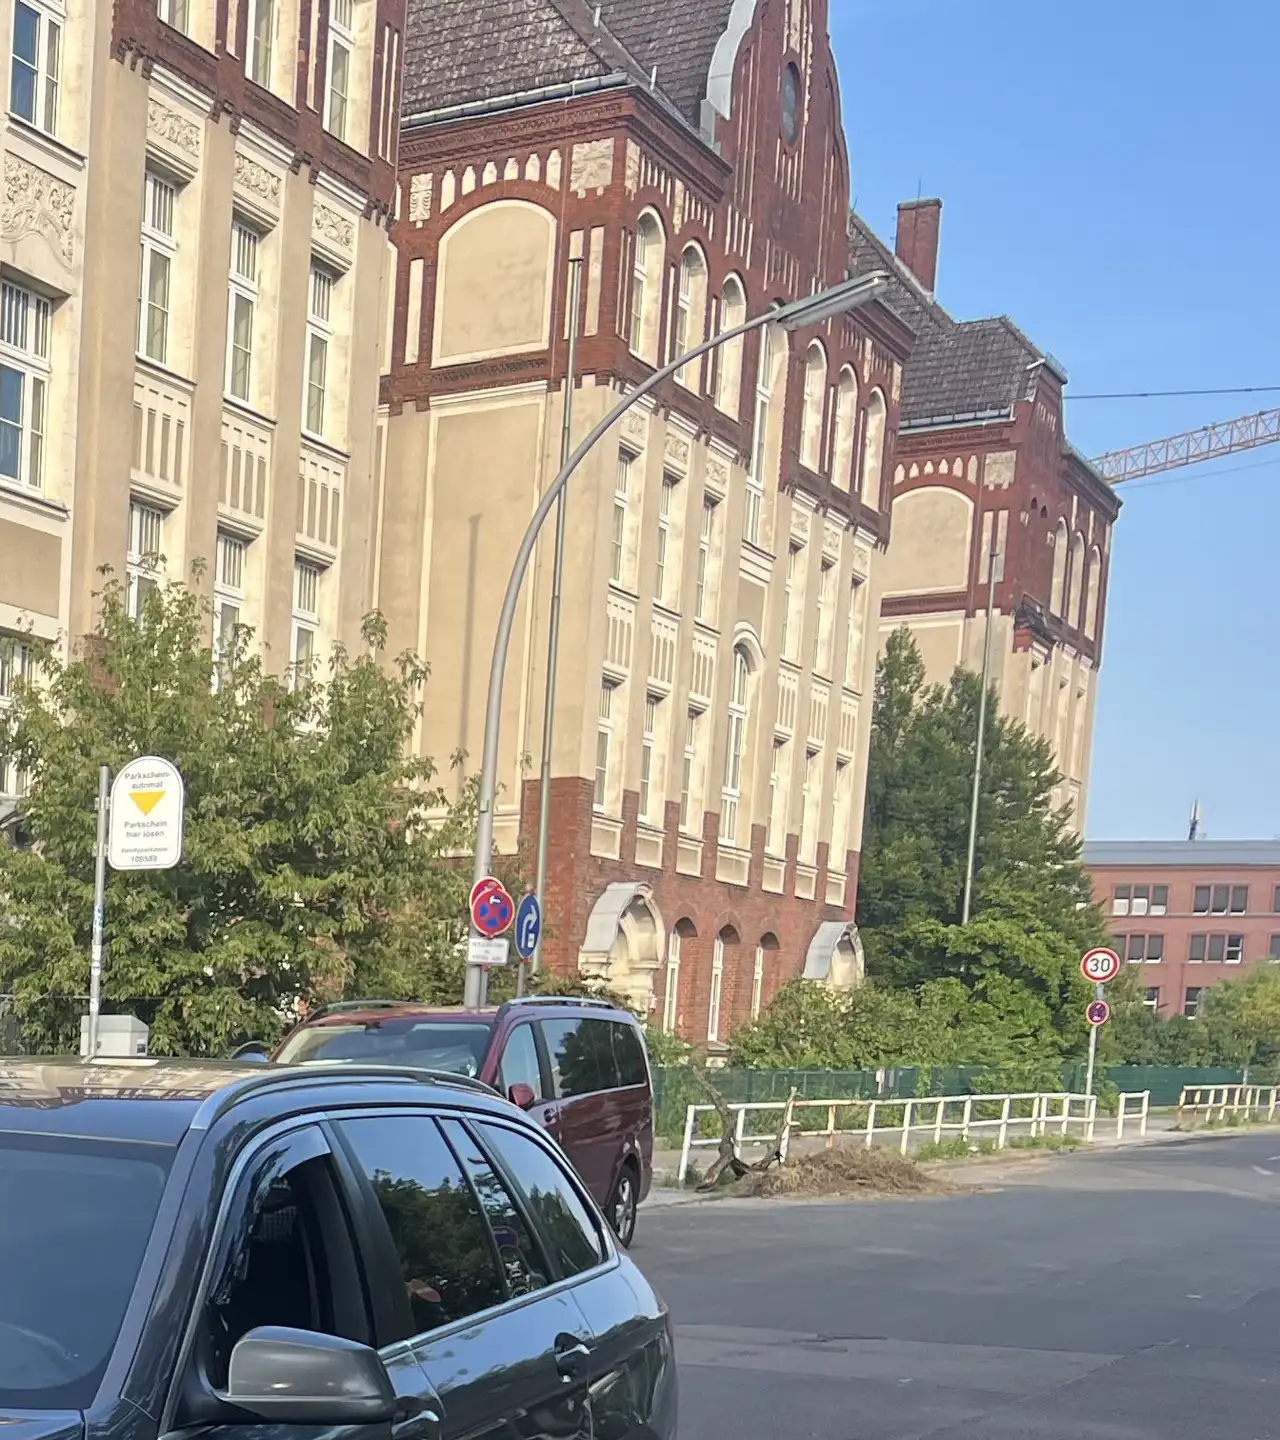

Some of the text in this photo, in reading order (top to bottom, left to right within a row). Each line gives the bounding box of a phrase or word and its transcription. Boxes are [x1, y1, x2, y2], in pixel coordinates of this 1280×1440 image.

[131, 781, 164, 789] automat
[124, 820, 168, 829] Parkschein
[1089, 958, 1110, 972] 30
